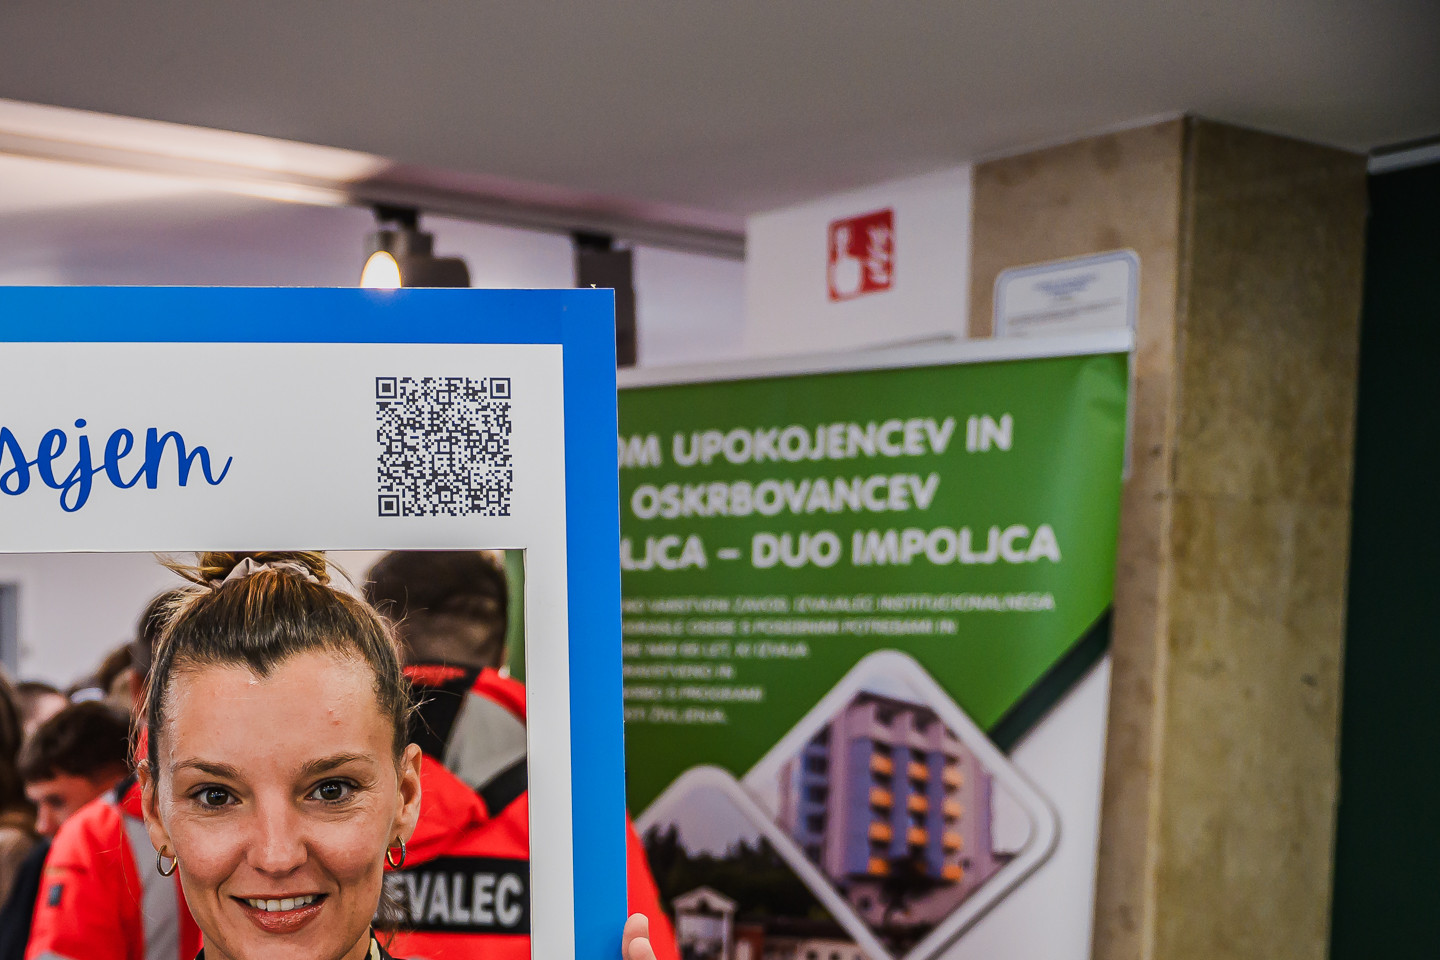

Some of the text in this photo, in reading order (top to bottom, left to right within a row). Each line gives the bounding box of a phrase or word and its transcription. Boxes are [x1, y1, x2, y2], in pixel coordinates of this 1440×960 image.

[672, 417, 956, 468] UPOKOJENCEV
[967, 414, 1014, 452] IN
[631, 473, 941, 520] OSKRBOVANCEV
[751, 531, 841, 569] DUO
[852, 524, 1061, 565] IMPOLJCA
